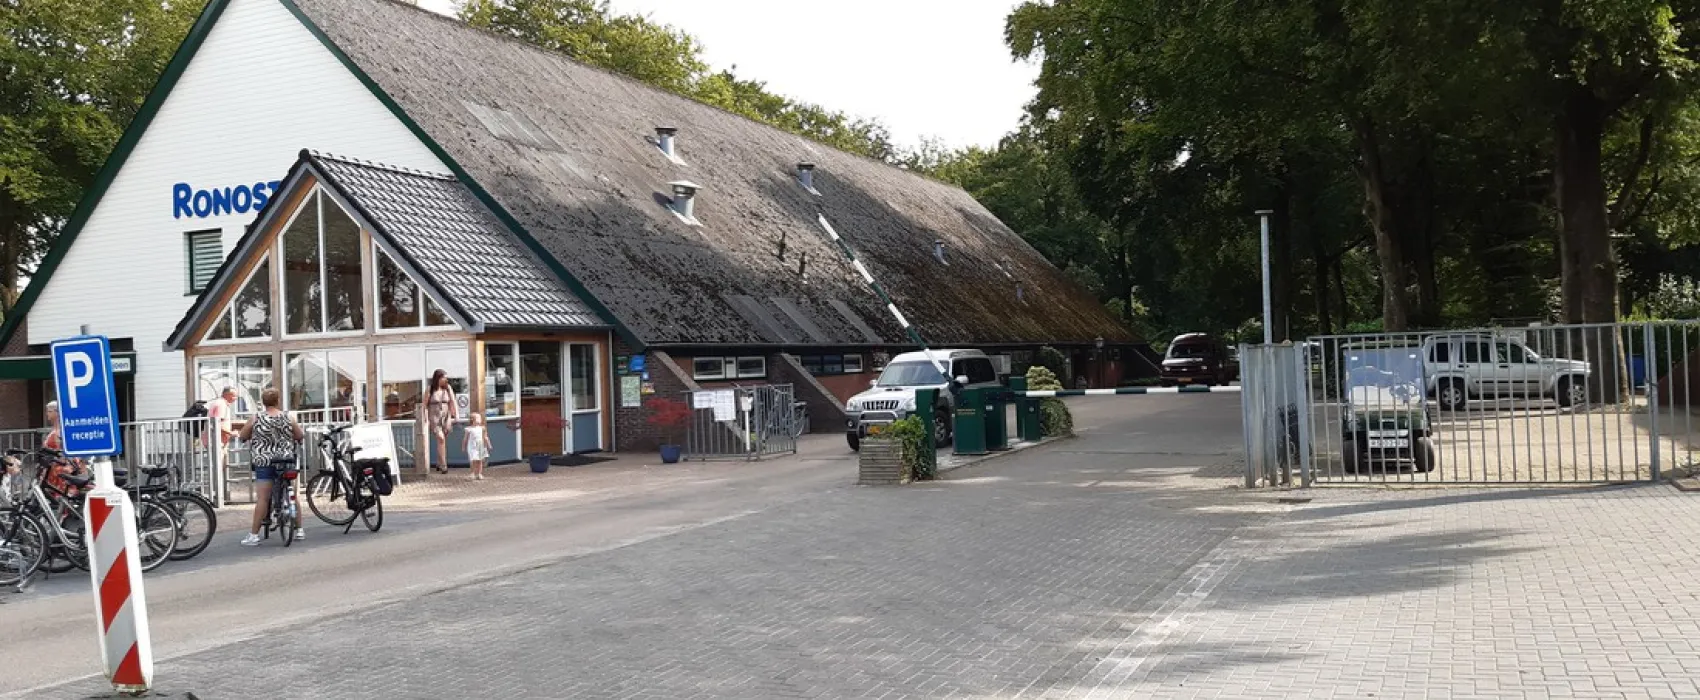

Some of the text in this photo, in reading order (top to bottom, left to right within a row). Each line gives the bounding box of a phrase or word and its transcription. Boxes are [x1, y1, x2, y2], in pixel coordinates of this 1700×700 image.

[64, 351, 94, 409] P
[64, 416, 110, 427] Aanmelden
[71, 430, 105, 440] receptie
